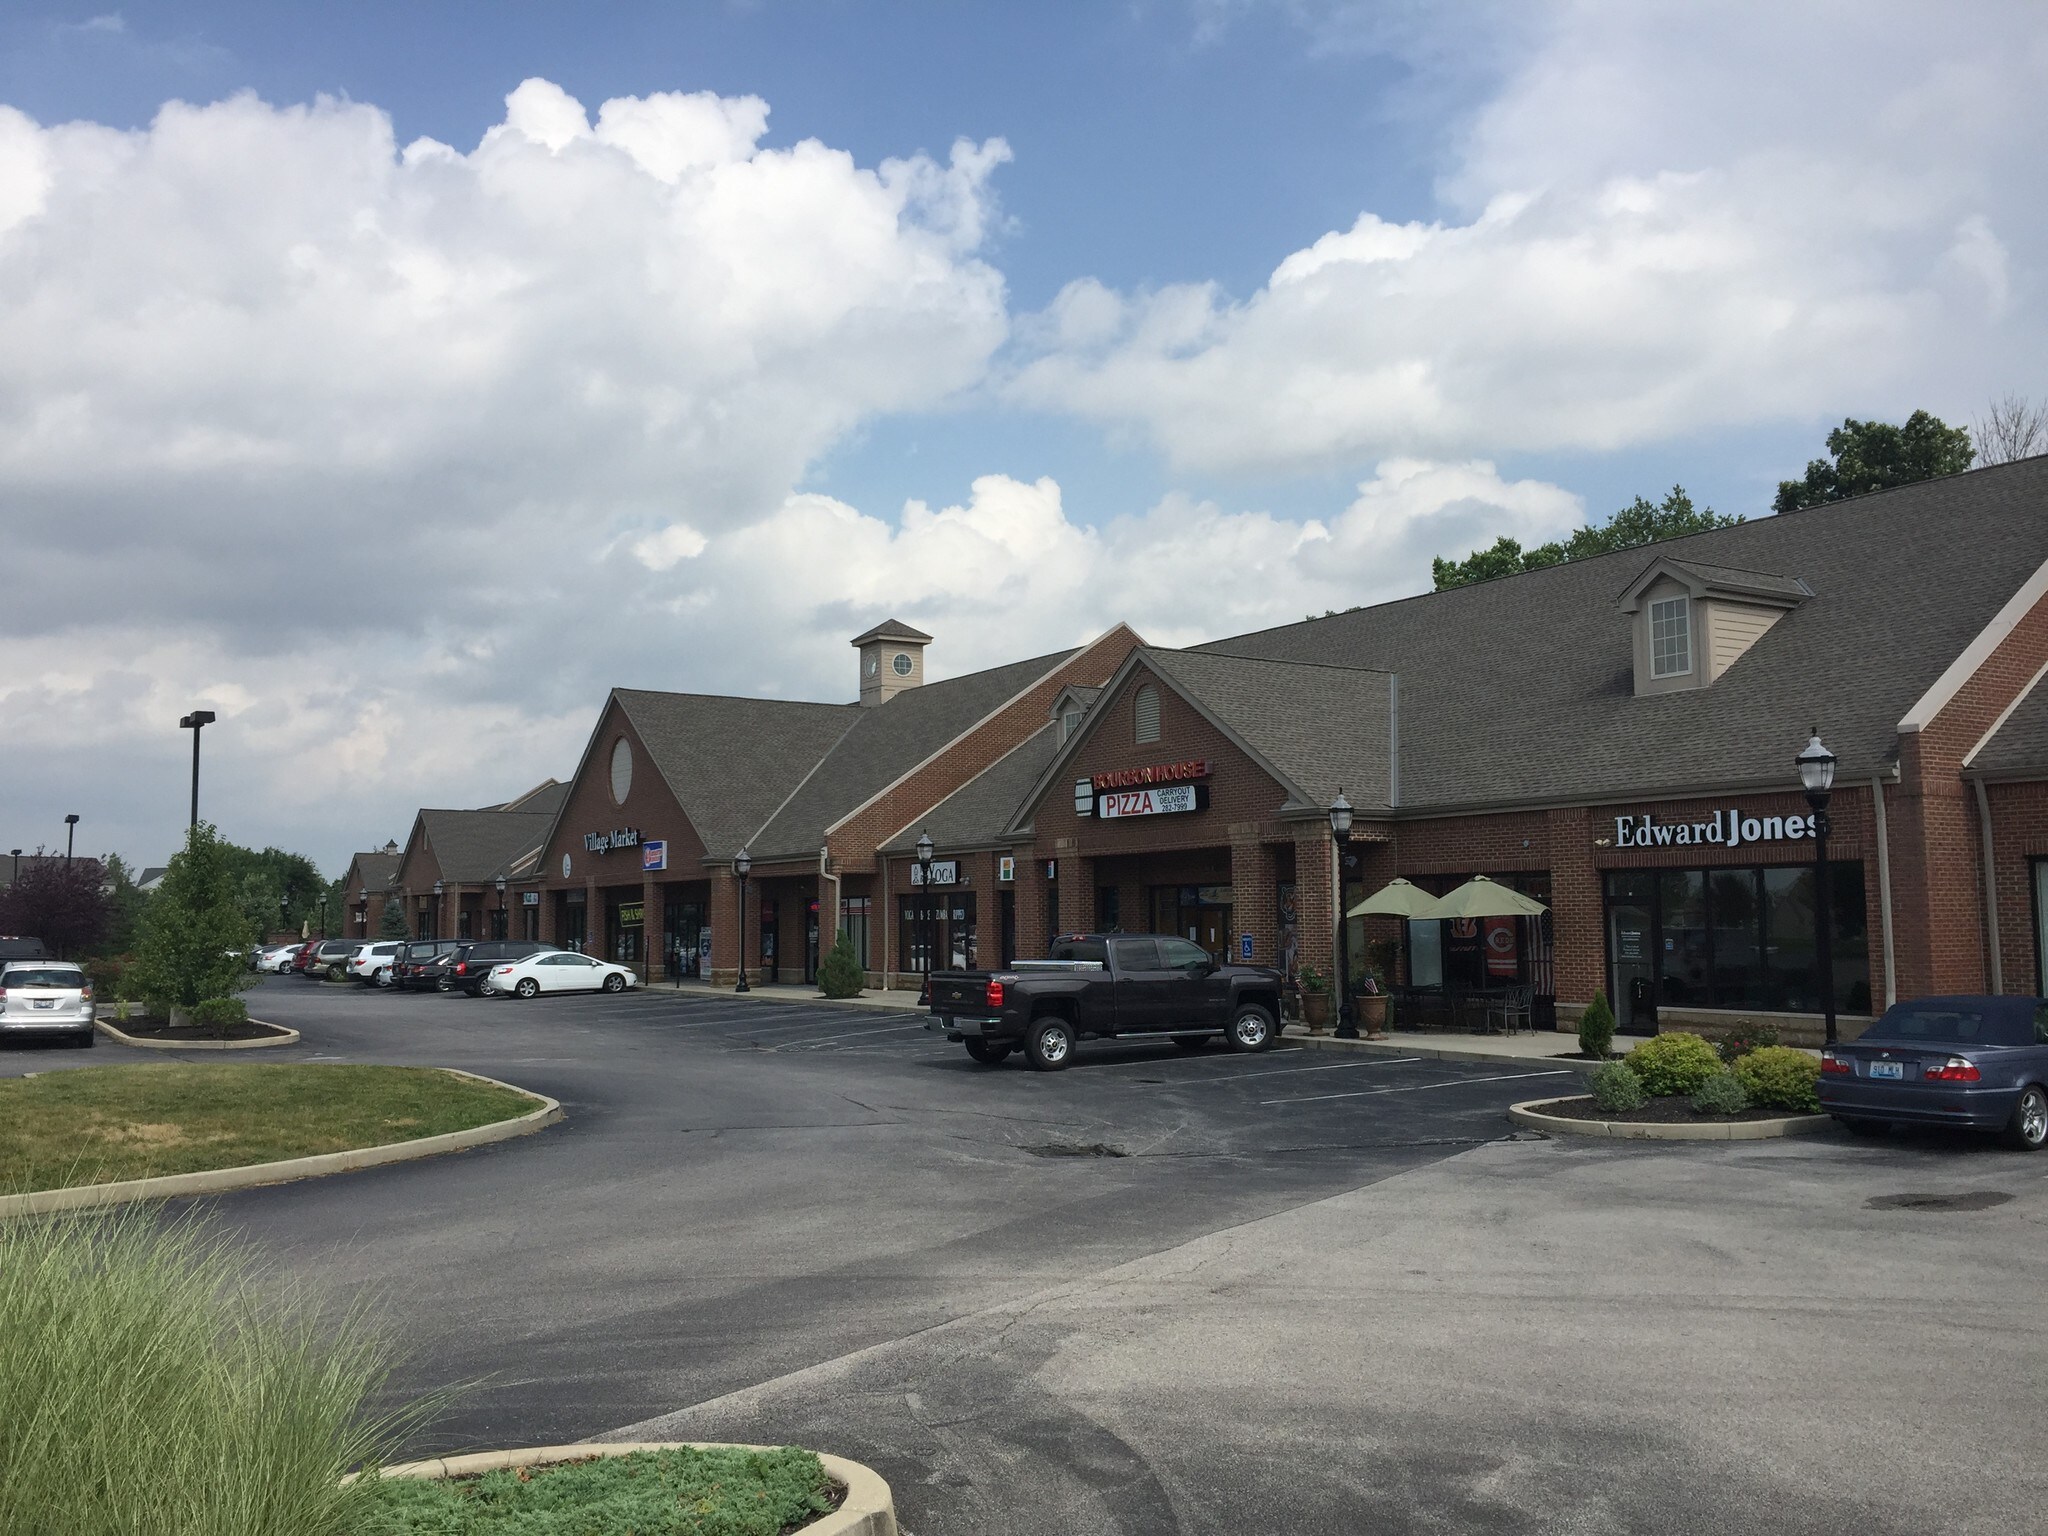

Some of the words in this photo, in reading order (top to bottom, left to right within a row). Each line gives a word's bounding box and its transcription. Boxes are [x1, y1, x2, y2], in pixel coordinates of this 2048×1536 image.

[1093, 765, 1153, 789] BOURBON
[1155, 759, 1206, 781] HOUSE
[1157, 787, 1190, 796] CARRYOUT
[1159, 795, 1189, 804] DELIVERY
[1106, 791, 1153, 816] PIZZA
[583, 831, 609, 855] Village
[610, 827, 639, 849] Market
[928, 864, 954, 883] YOGA
